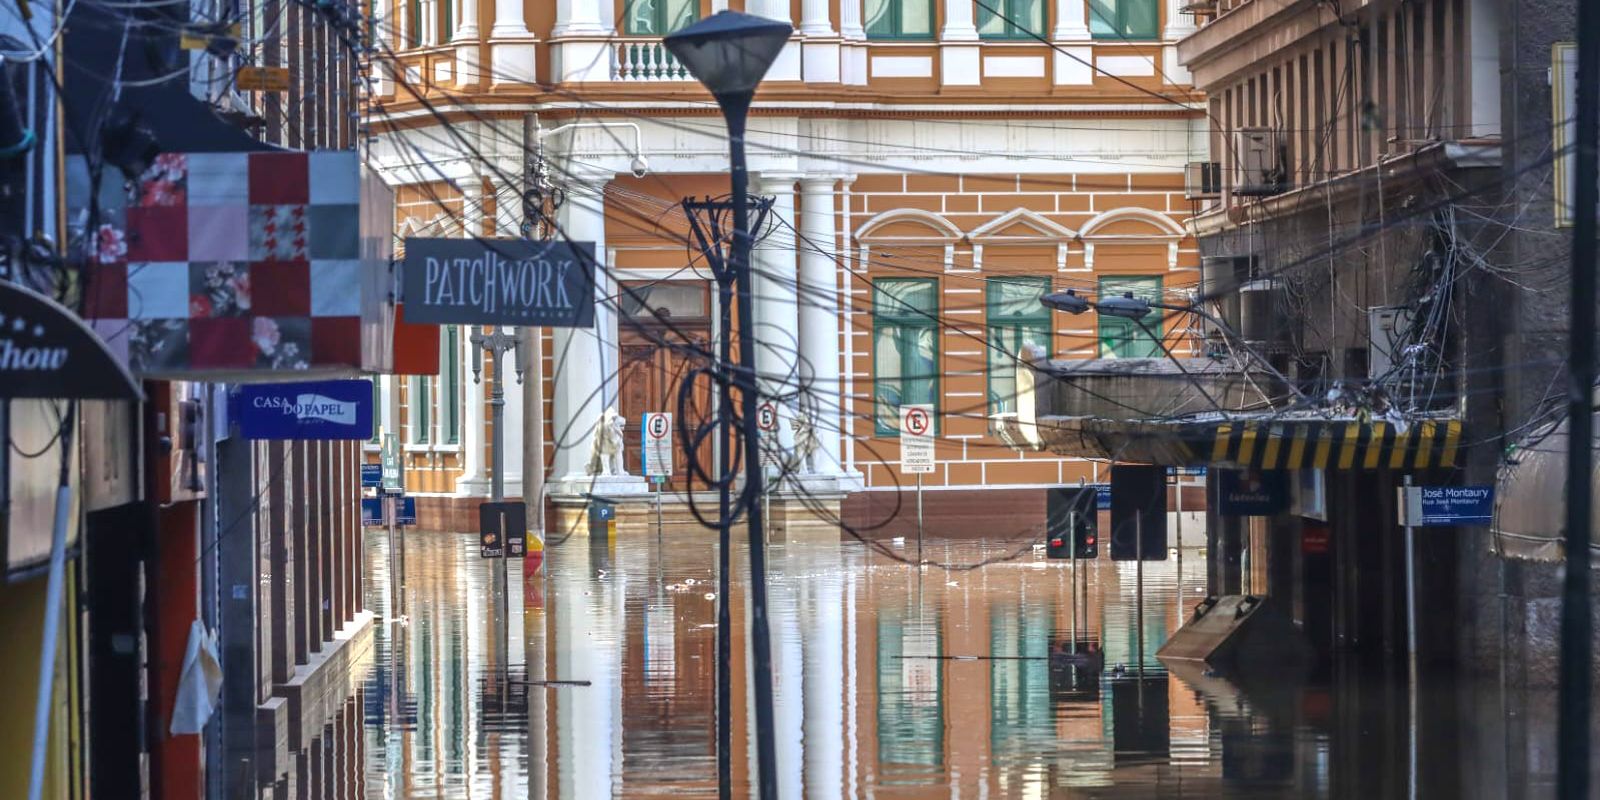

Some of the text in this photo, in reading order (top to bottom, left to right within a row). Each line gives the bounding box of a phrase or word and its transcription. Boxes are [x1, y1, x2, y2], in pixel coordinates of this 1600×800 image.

[424, 251, 573, 313] PATCHWORK
[253, 396, 290, 408] CASA
[283, 403, 344, 415] DO PAPEL
[1423, 488, 1489, 499] José Montaury
